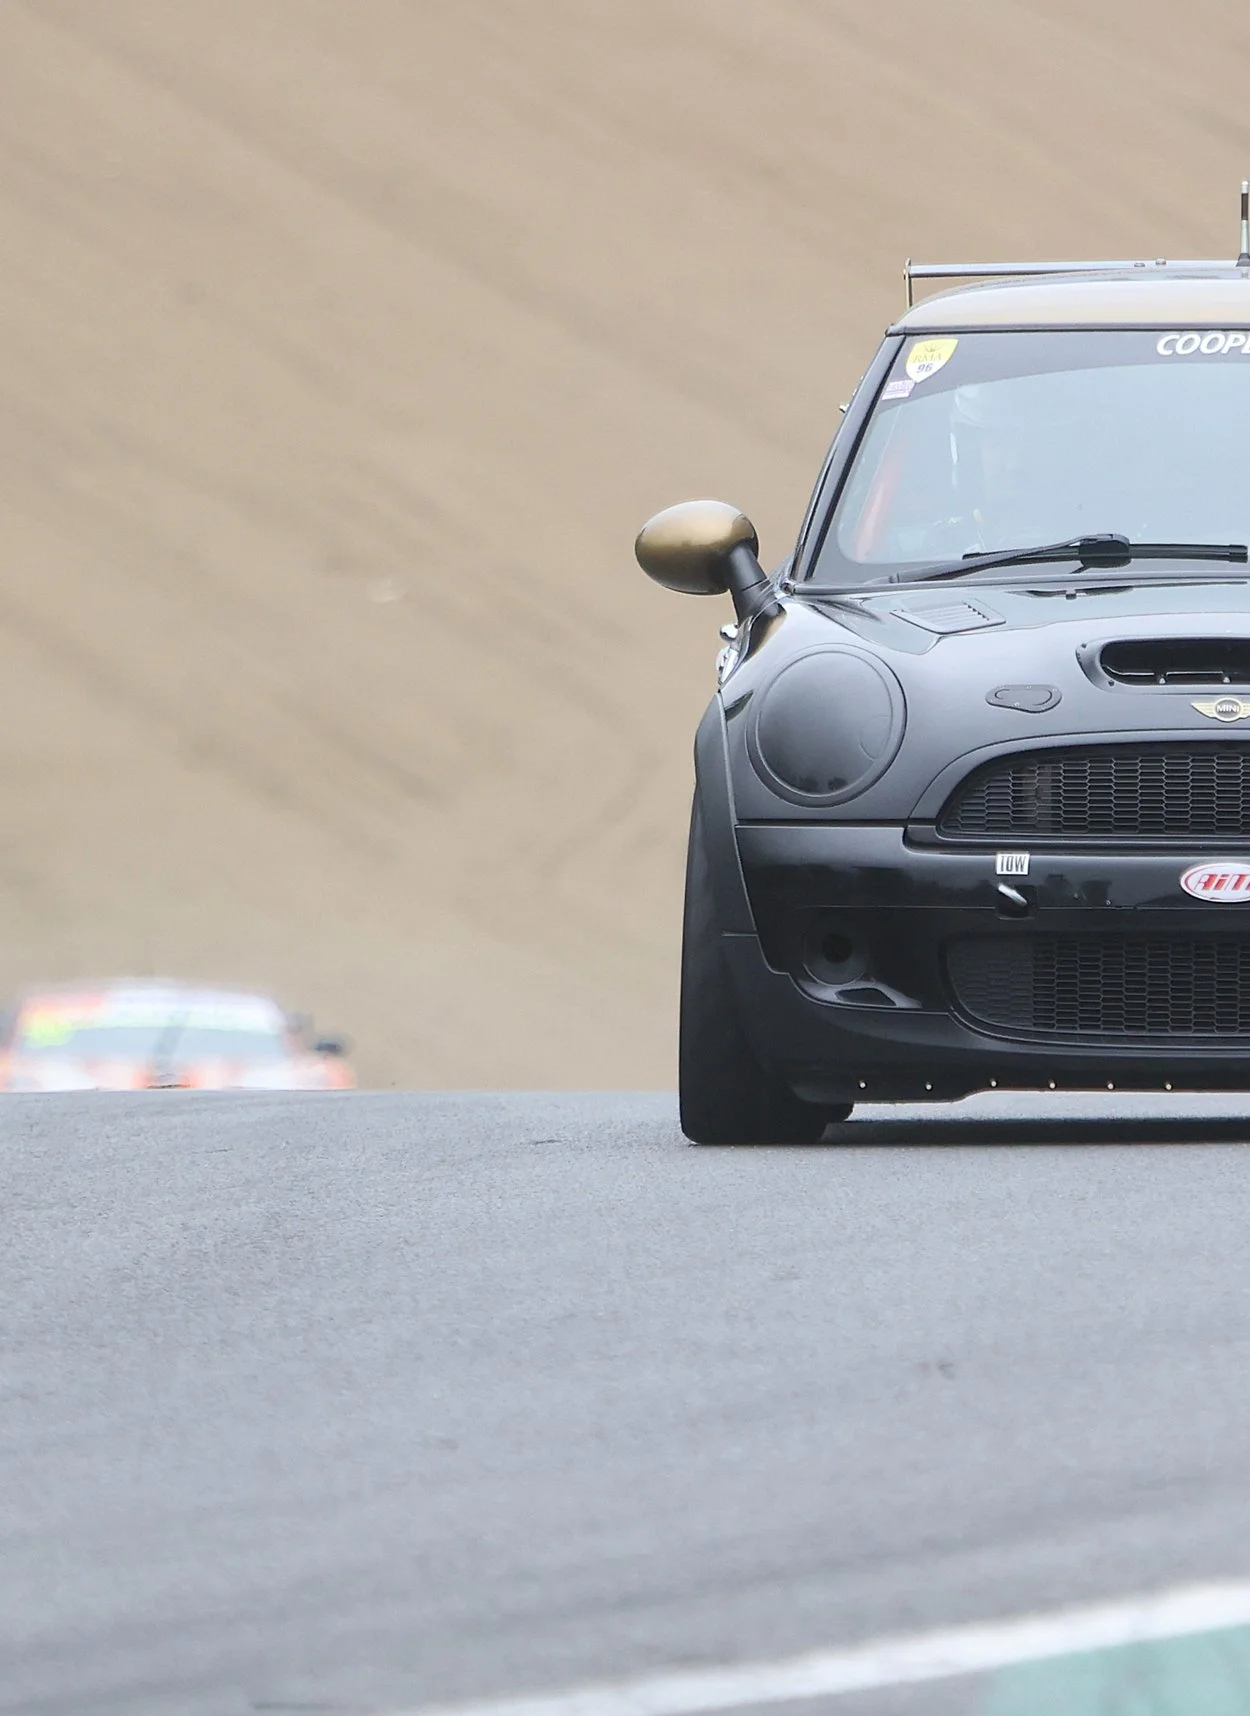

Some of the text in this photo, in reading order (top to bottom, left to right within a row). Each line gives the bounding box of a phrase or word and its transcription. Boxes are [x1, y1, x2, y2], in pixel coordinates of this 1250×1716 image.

[916, 363, 933, 373] 96
[1216, 704, 1240, 713] MINI
[1000, 855, 1027, 873] TOW
